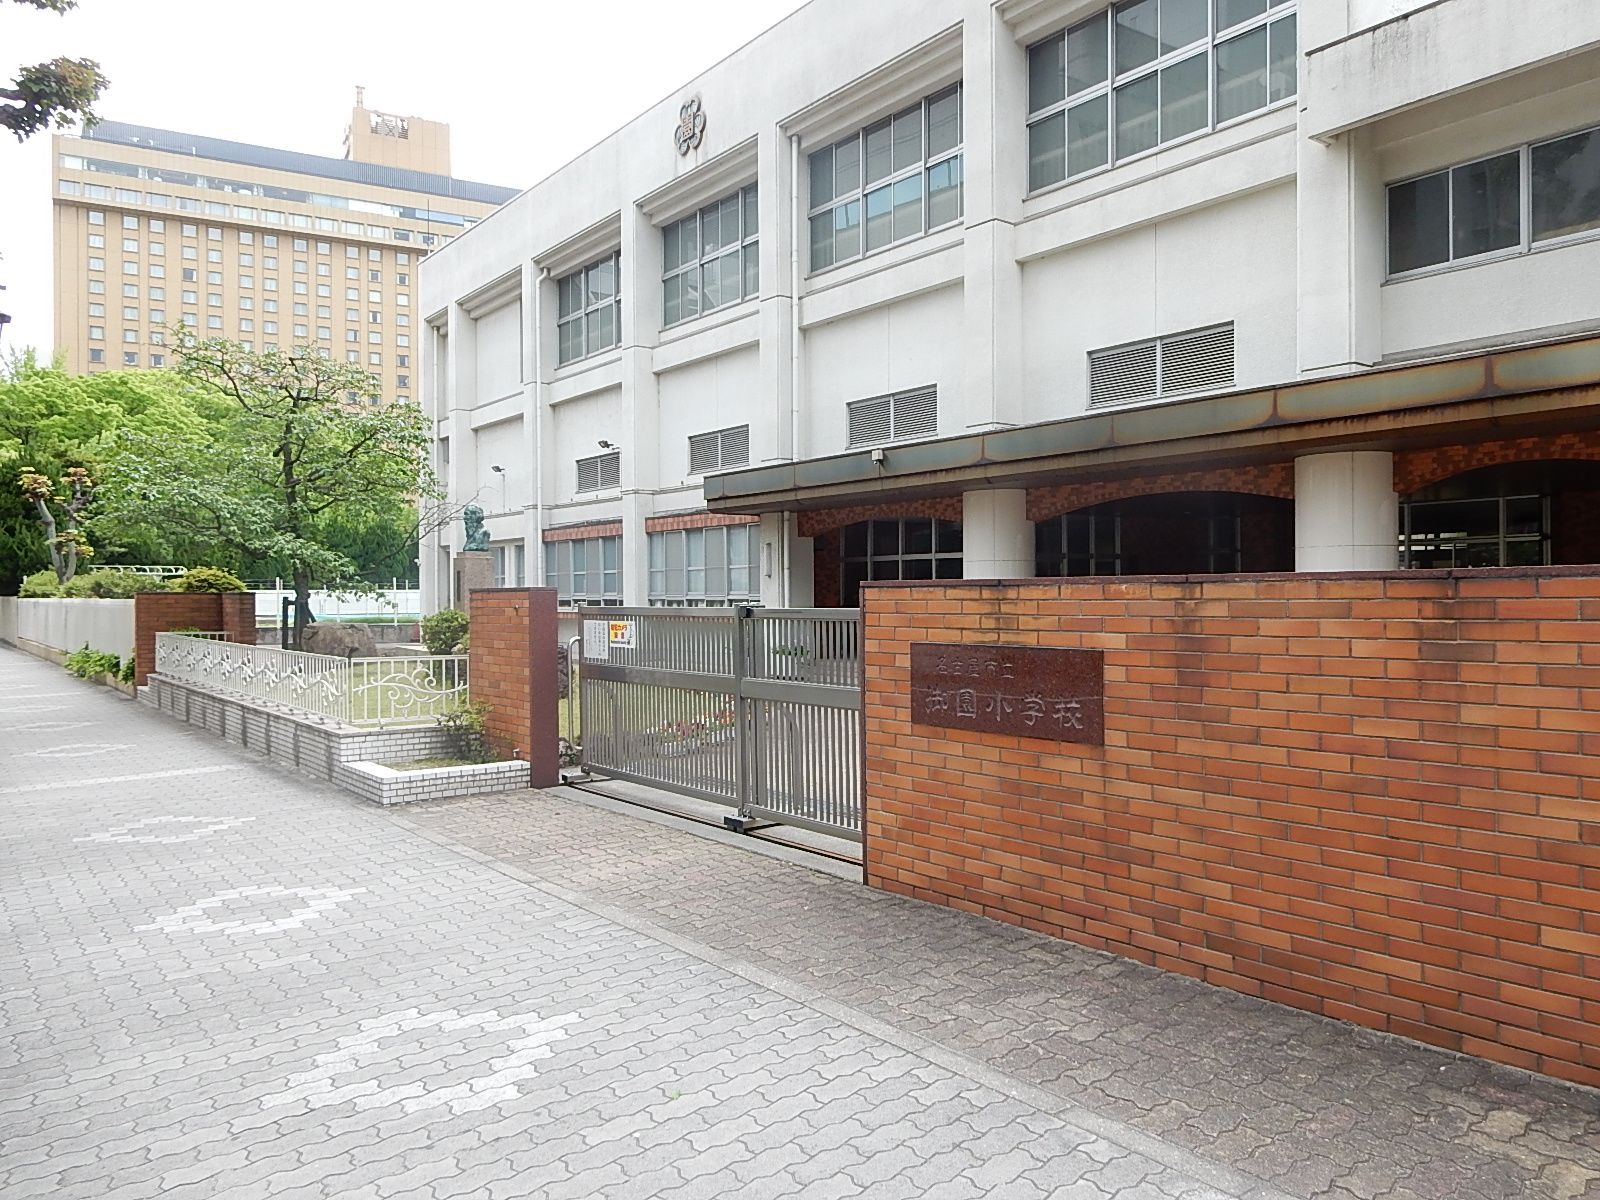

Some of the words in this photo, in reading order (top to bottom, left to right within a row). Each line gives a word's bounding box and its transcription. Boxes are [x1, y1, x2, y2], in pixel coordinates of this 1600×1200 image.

[925, 684, 1084, 729] 御園小学校
